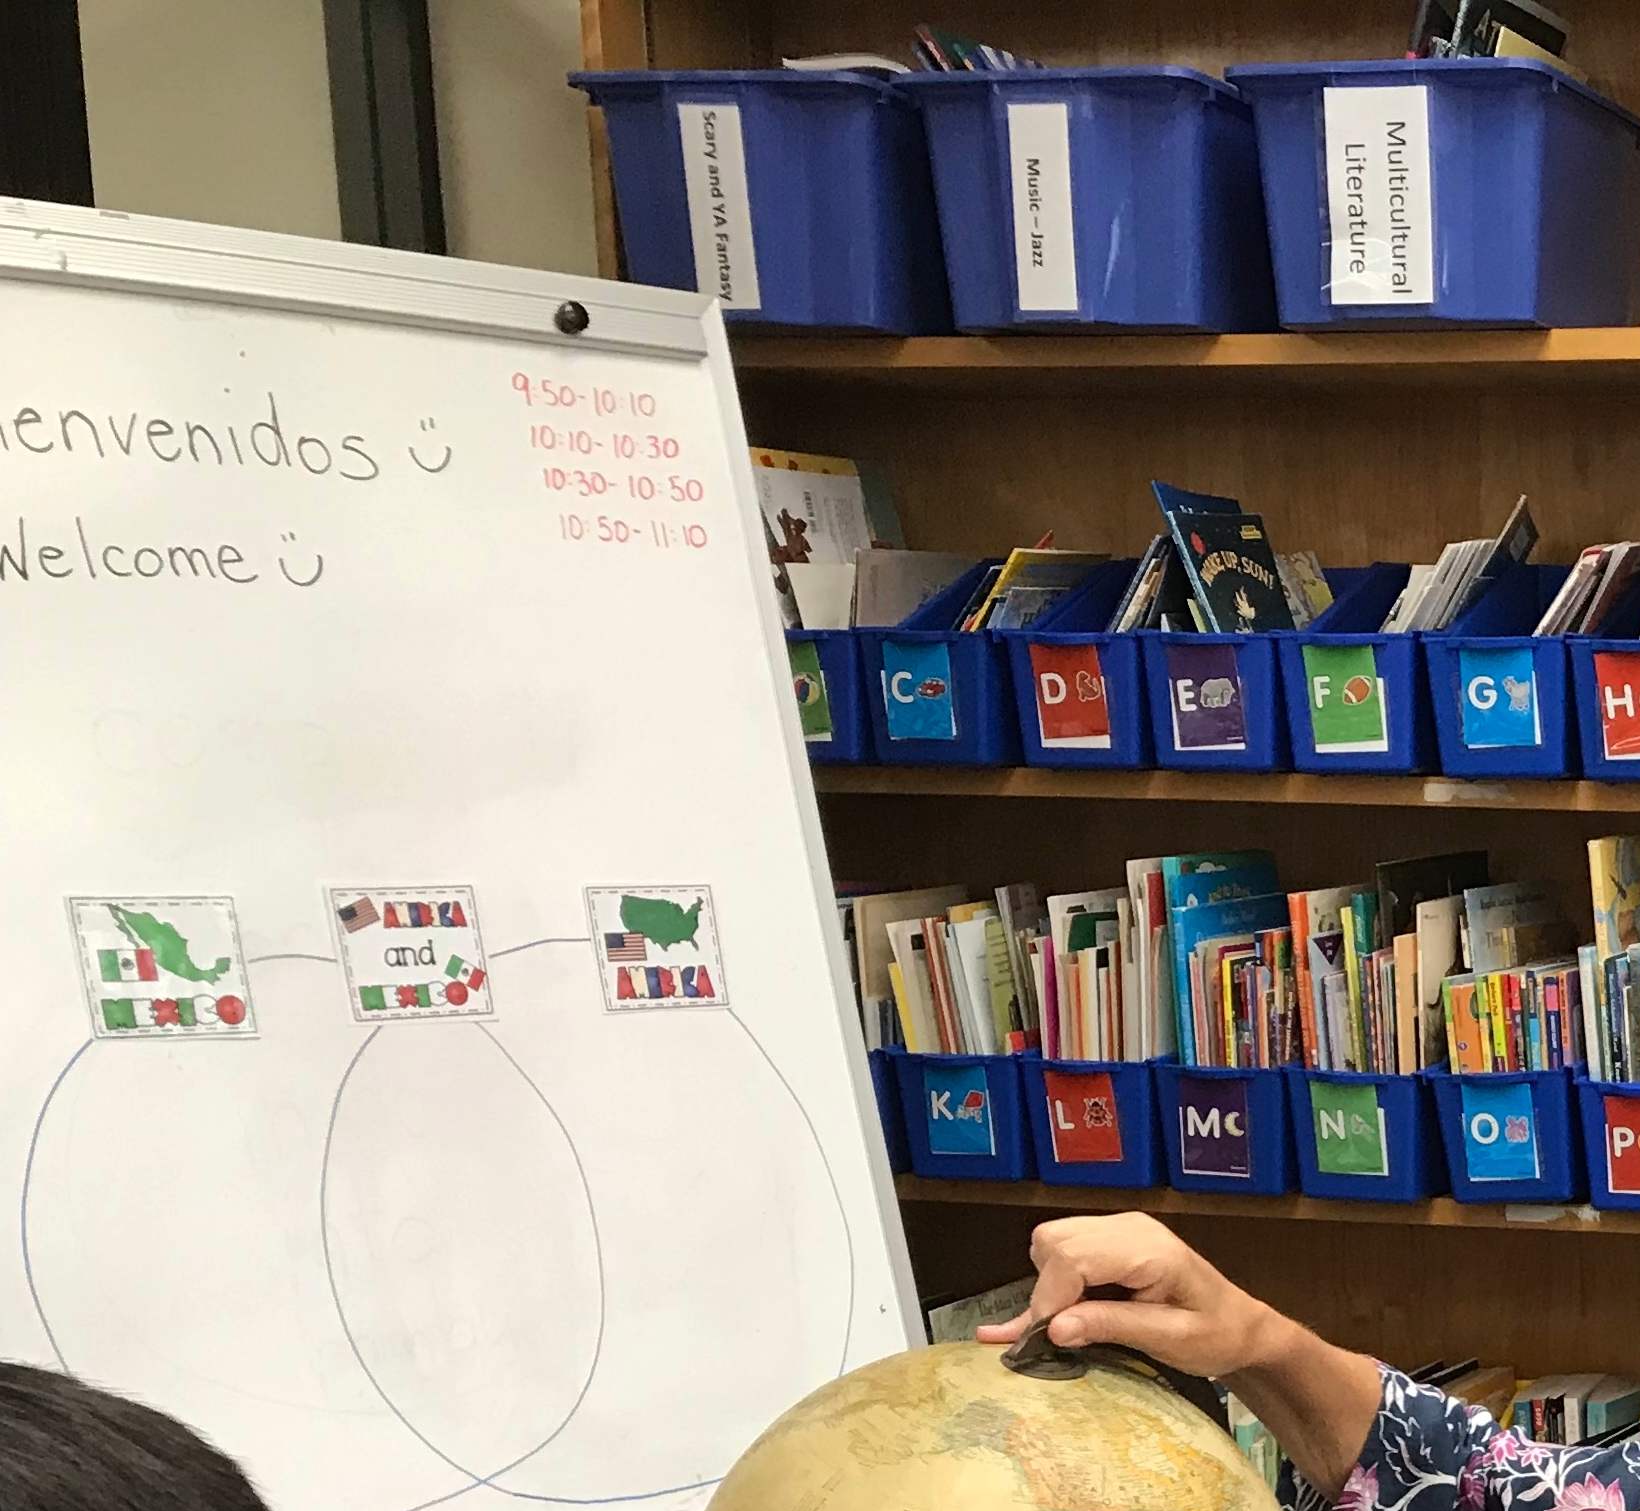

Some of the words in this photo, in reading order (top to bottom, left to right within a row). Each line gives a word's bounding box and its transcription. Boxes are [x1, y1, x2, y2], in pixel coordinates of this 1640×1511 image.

[702, 111, 718, 160] Scary
[707, 165, 724, 198] and
[1026, 158, 1041, 212] Music
[712, 202, 728, 227] YA
[1345, 143, 1367, 275] Literature
[1386, 121, 1412, 294] Multicultural
[1031, 232, 1044, 268] Jazz
[716, 233, 733, 302] Fantasy
[512, 372, 656, 417] 9:50-10:10
[1200, 552, 1226, 588] WAKE
[891, 671, 915, 703] C
[1041, 672, 1066, 704] D
[1177, 679, 1197, 712] E
[1313, 676, 1331, 708] F
[1468, 677, 1498, 710] G
[1605, 684, 1633, 719] H
[383, 901, 467, 929] AMERICA
[384, 940, 436, 967] and
[359, 980, 468, 1011] MEXICO
[617, 965, 715, 999] AMERICA
[100, 993, 246, 1030] MEXICO
[930, 1090, 958, 1122] K
[1056, 1094, 1074, 1130] L
[1187, 1106, 1221, 1138] M
[1320, 1107, 1349, 1137] N
[1471, 1112, 1499, 1146] O
[1614, 1124, 1636, 1158] P
